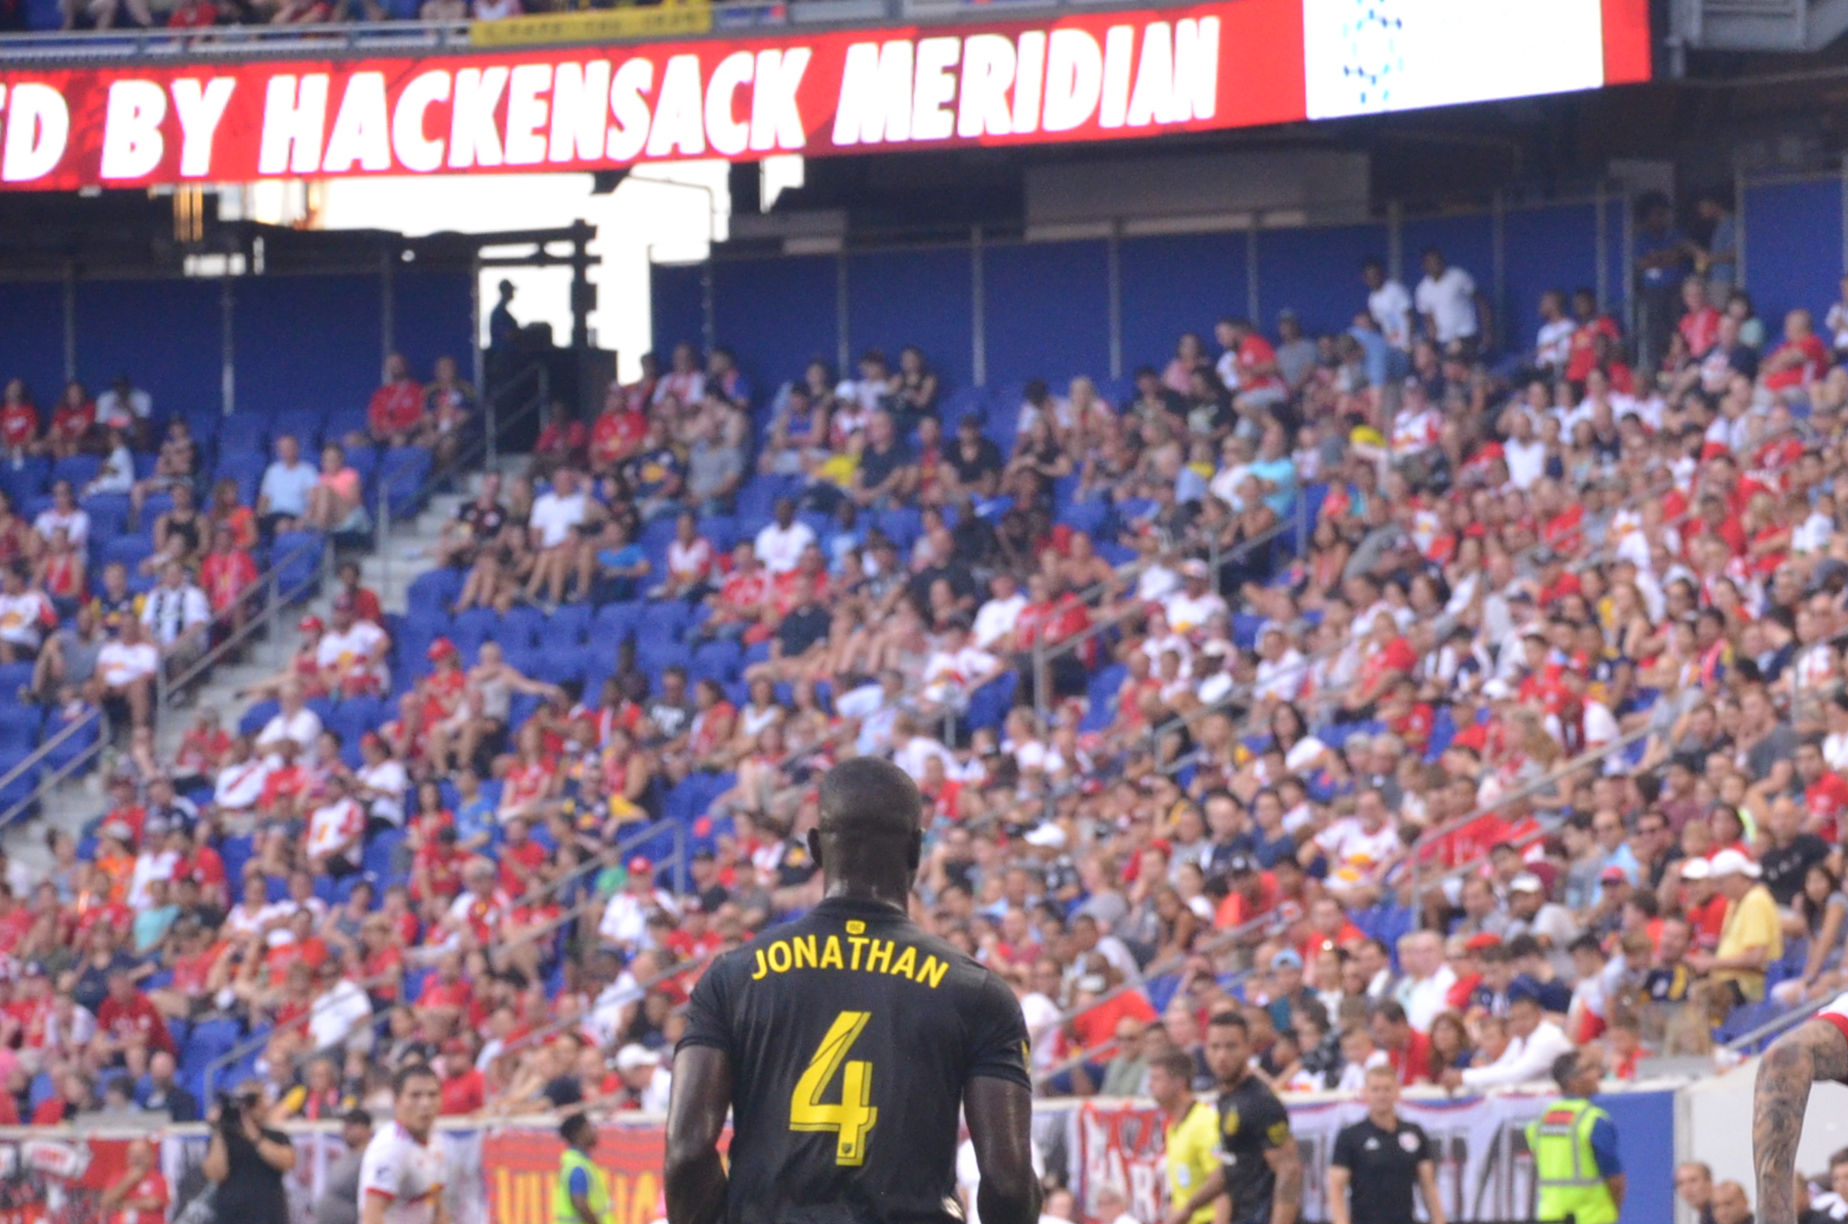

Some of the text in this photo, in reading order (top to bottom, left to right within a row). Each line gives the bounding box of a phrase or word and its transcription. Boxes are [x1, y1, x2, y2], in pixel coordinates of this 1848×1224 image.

[100, 77, 235, 179] BY
[258, 47, 812, 176] HACKENSACK
[833, 17, 1220, 147] MERIDIAN
[751, 933, 950, 989] JONATHAN
[789, 1010, 878, 1166] 4
